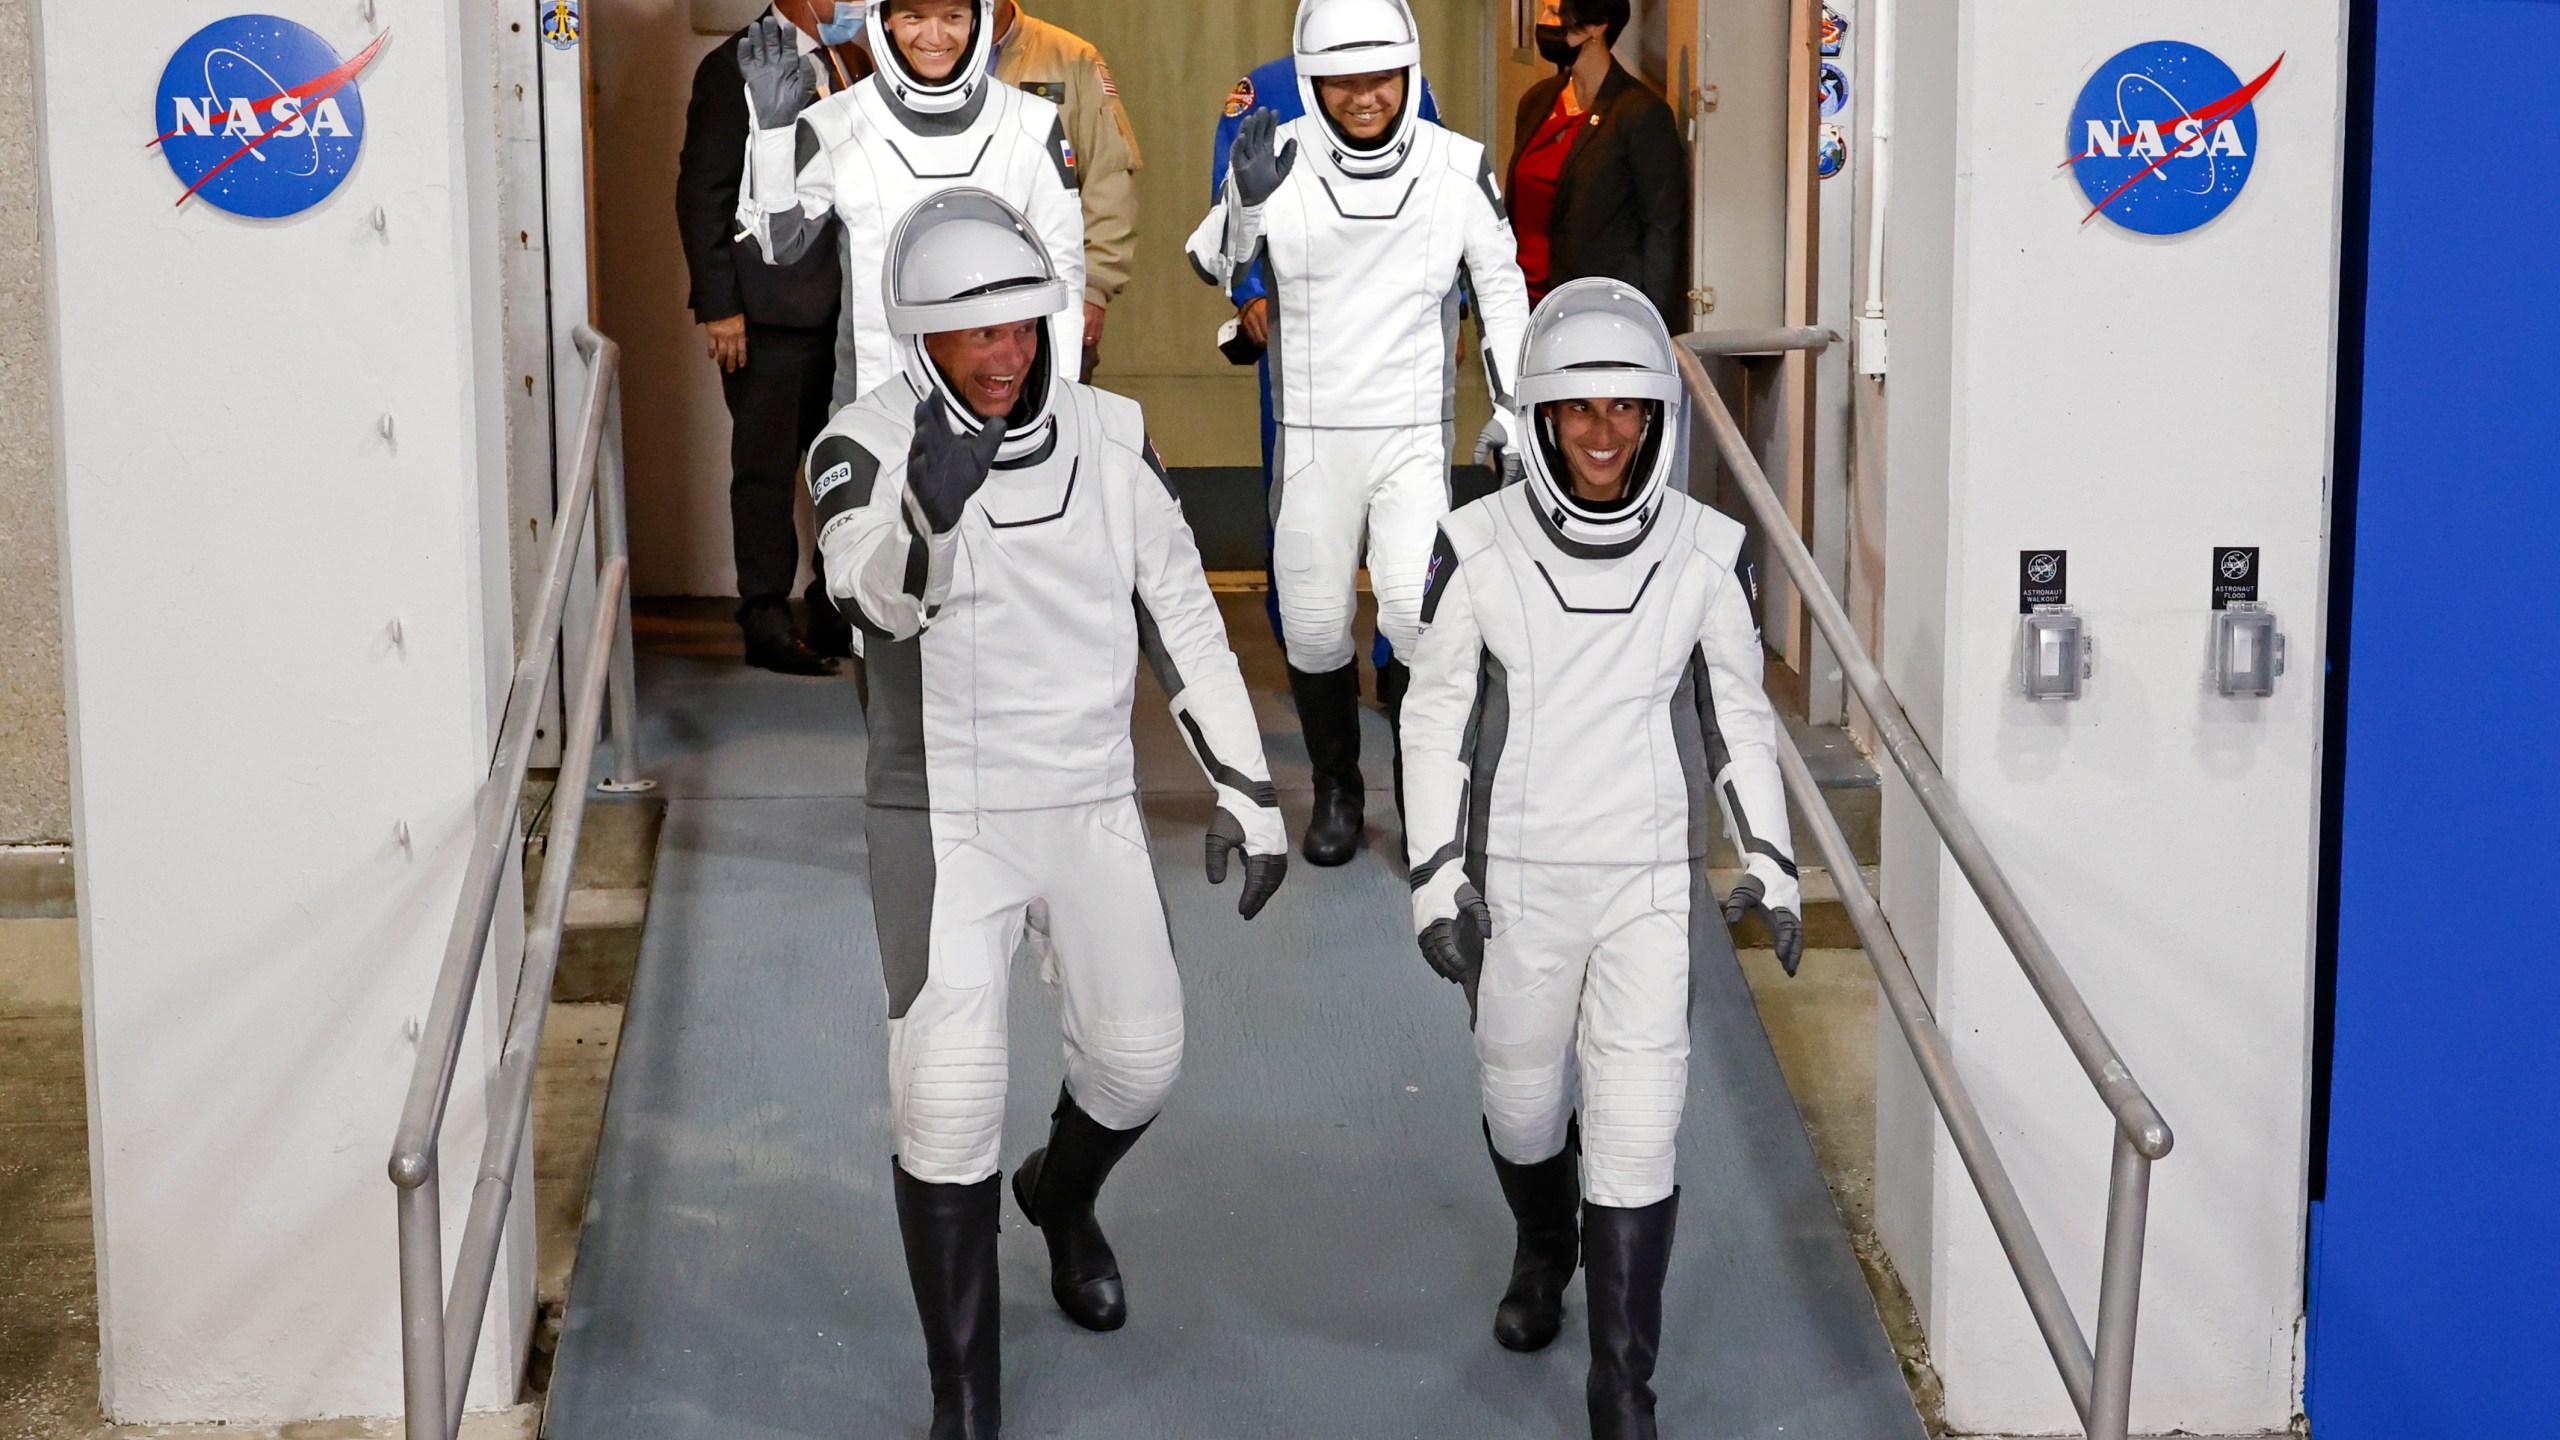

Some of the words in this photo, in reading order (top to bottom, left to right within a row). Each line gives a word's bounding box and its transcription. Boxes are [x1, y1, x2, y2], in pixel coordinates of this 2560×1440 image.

[172, 97, 353, 138] NASA
[2084, 119, 2247, 158] NASA
[823, 467, 849, 487] esa
